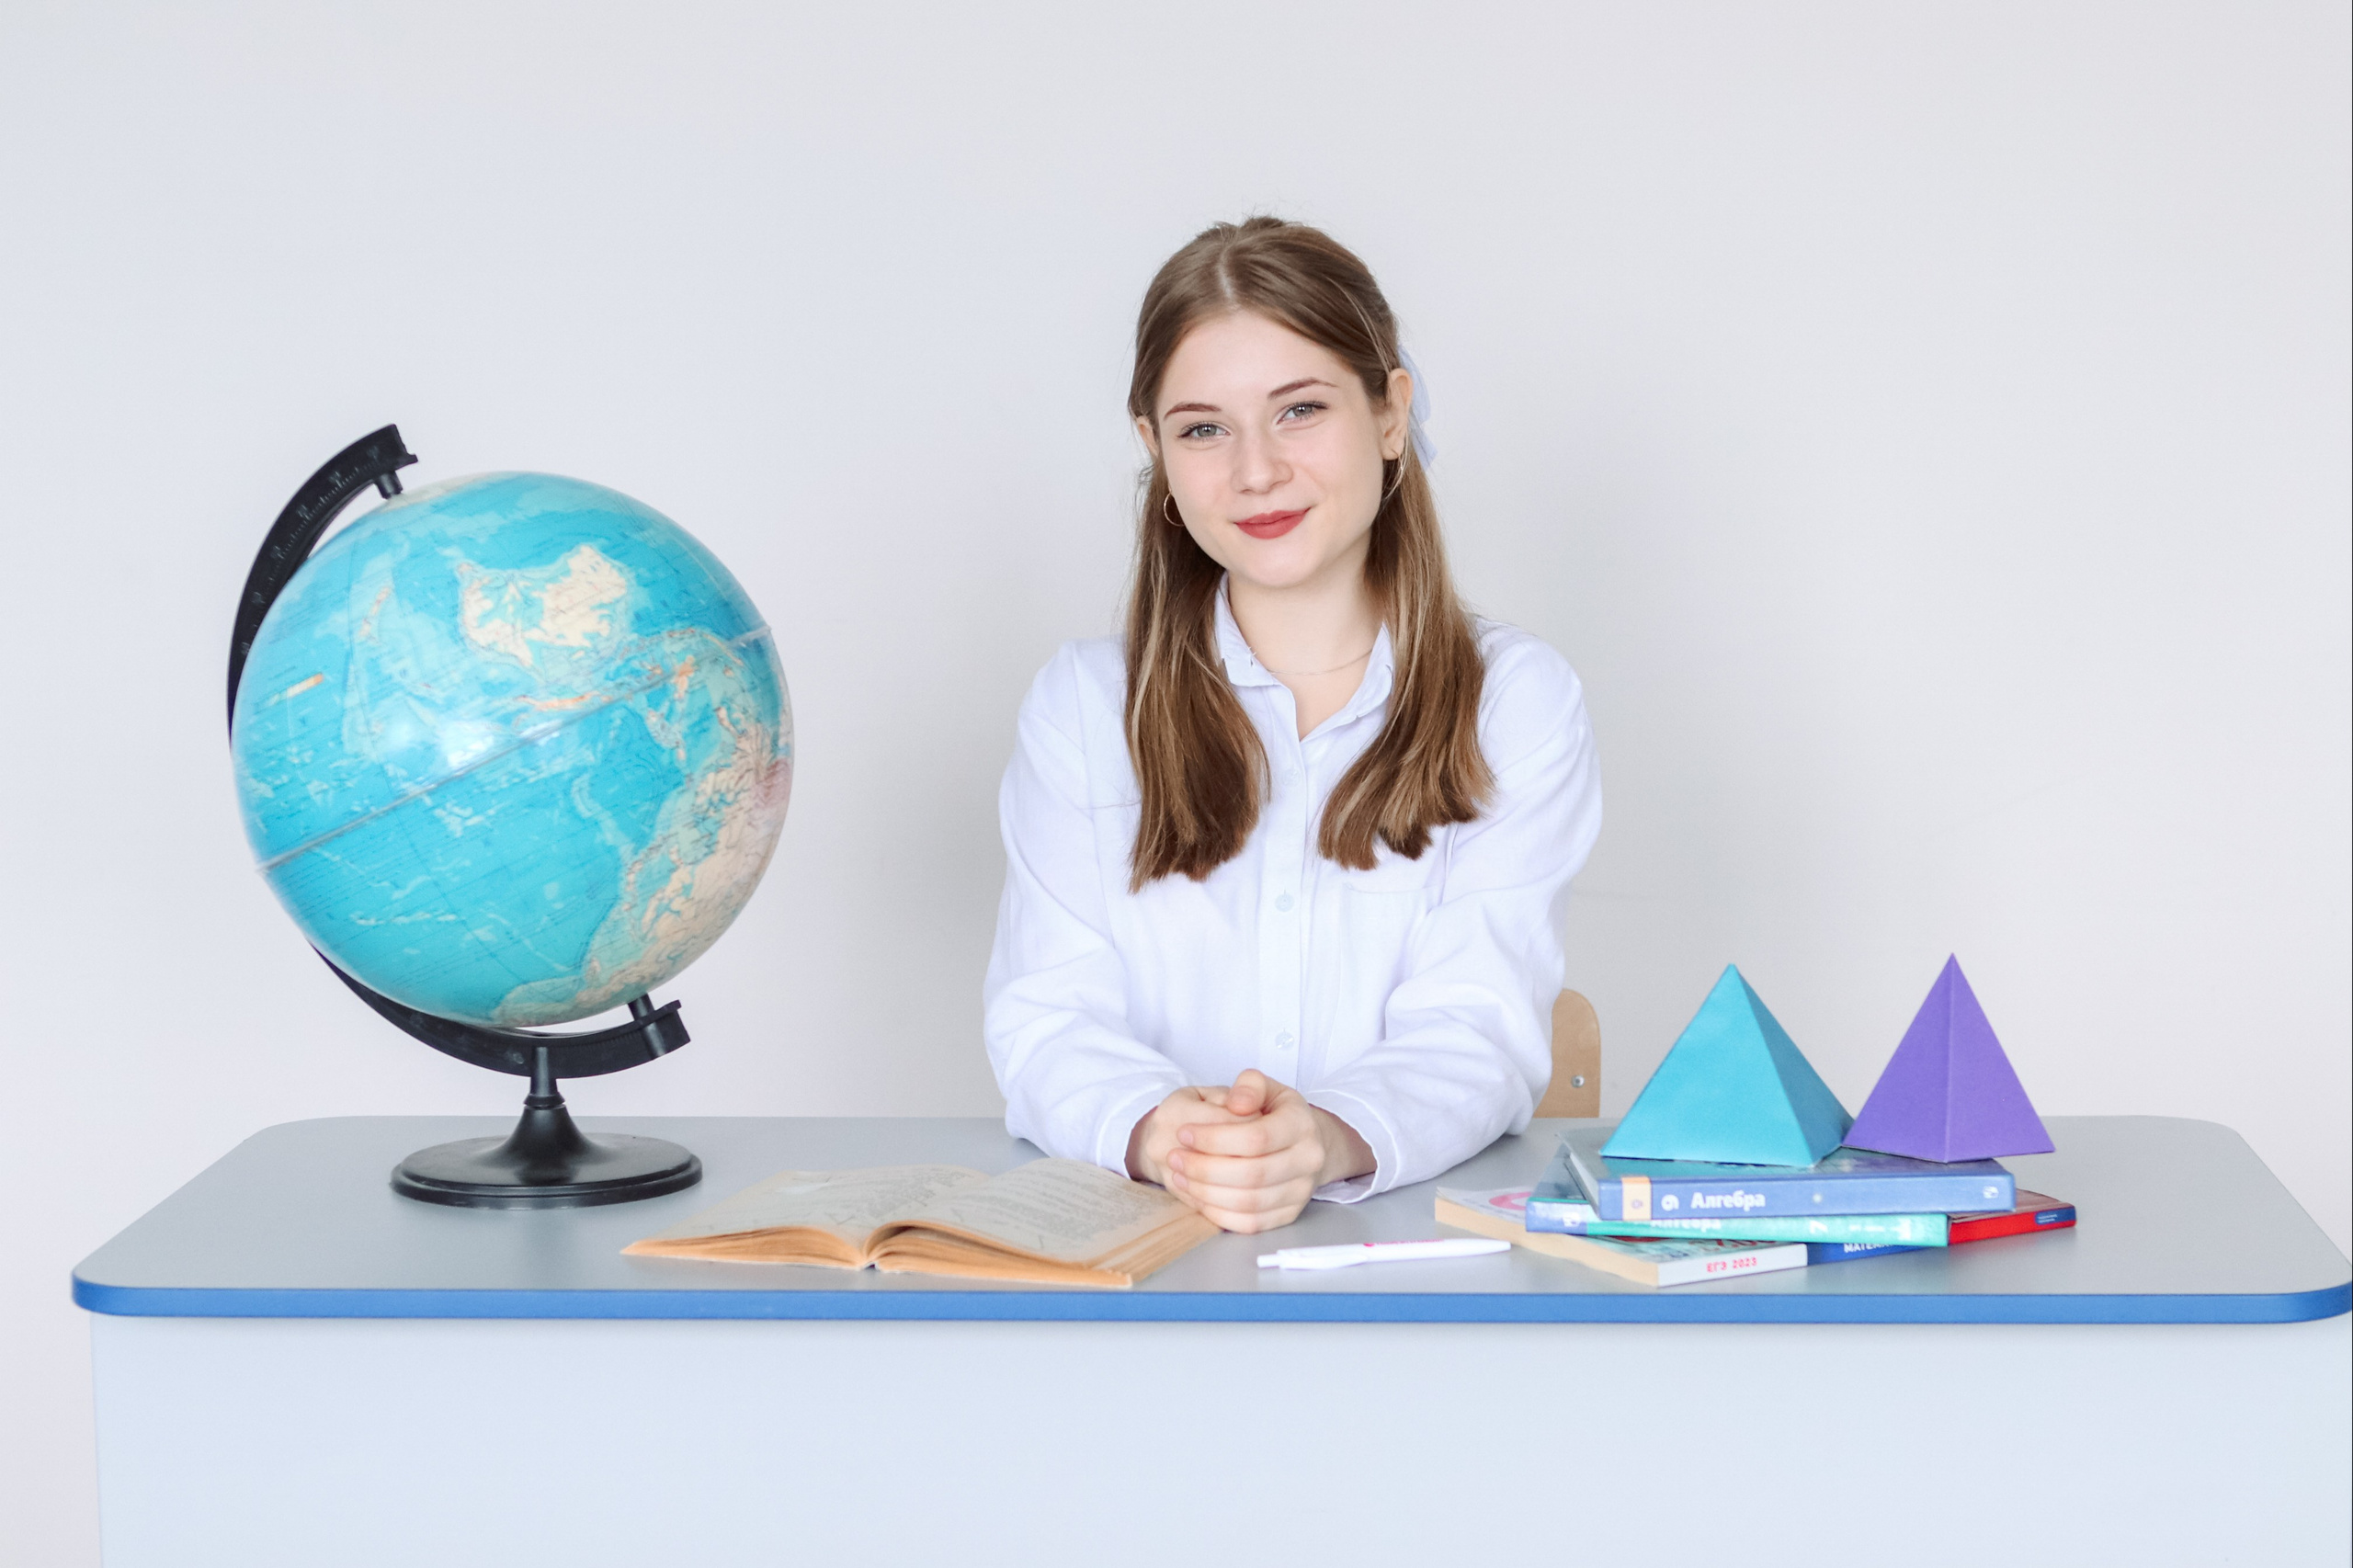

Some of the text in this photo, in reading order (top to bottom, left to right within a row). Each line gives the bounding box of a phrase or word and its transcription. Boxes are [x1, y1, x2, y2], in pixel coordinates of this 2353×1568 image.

[1691, 1190, 1766, 1211] Алгебра
[1707, 1256, 1757, 1273] ЕГЭ 2023
